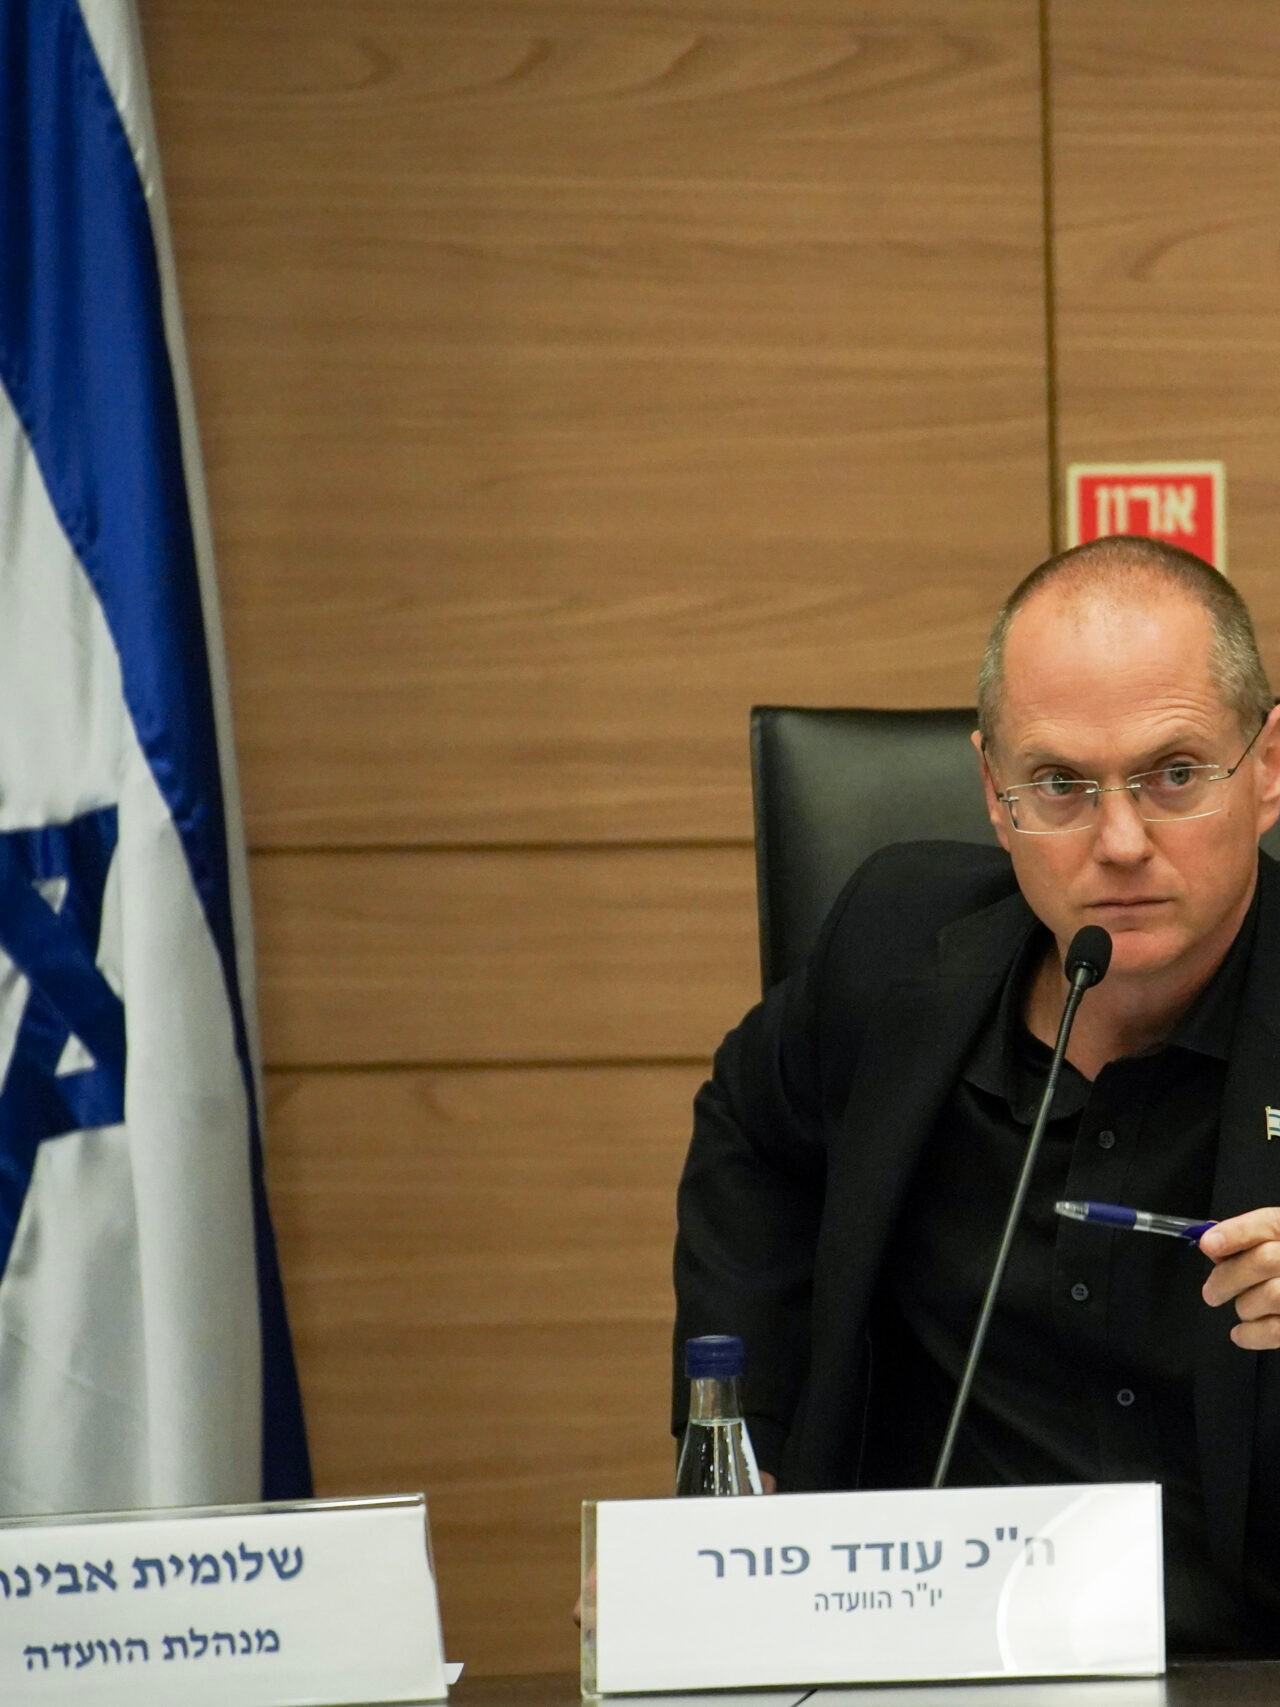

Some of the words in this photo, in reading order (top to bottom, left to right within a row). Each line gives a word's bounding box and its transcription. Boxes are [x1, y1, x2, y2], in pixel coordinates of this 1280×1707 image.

[1095, 484, 1195, 536] ארון
[132, 1541, 304, 1590] שלומית
[697, 1546, 810, 1579] פורר
[830, 1540, 944, 1574] עודד
[814, 1590, 893, 1613] הוועדה
[901, 1582, 942, 1608] יו"ר
[23, 1636, 150, 1671] הוועדה
[162, 1626, 281, 1661] מנהלת
